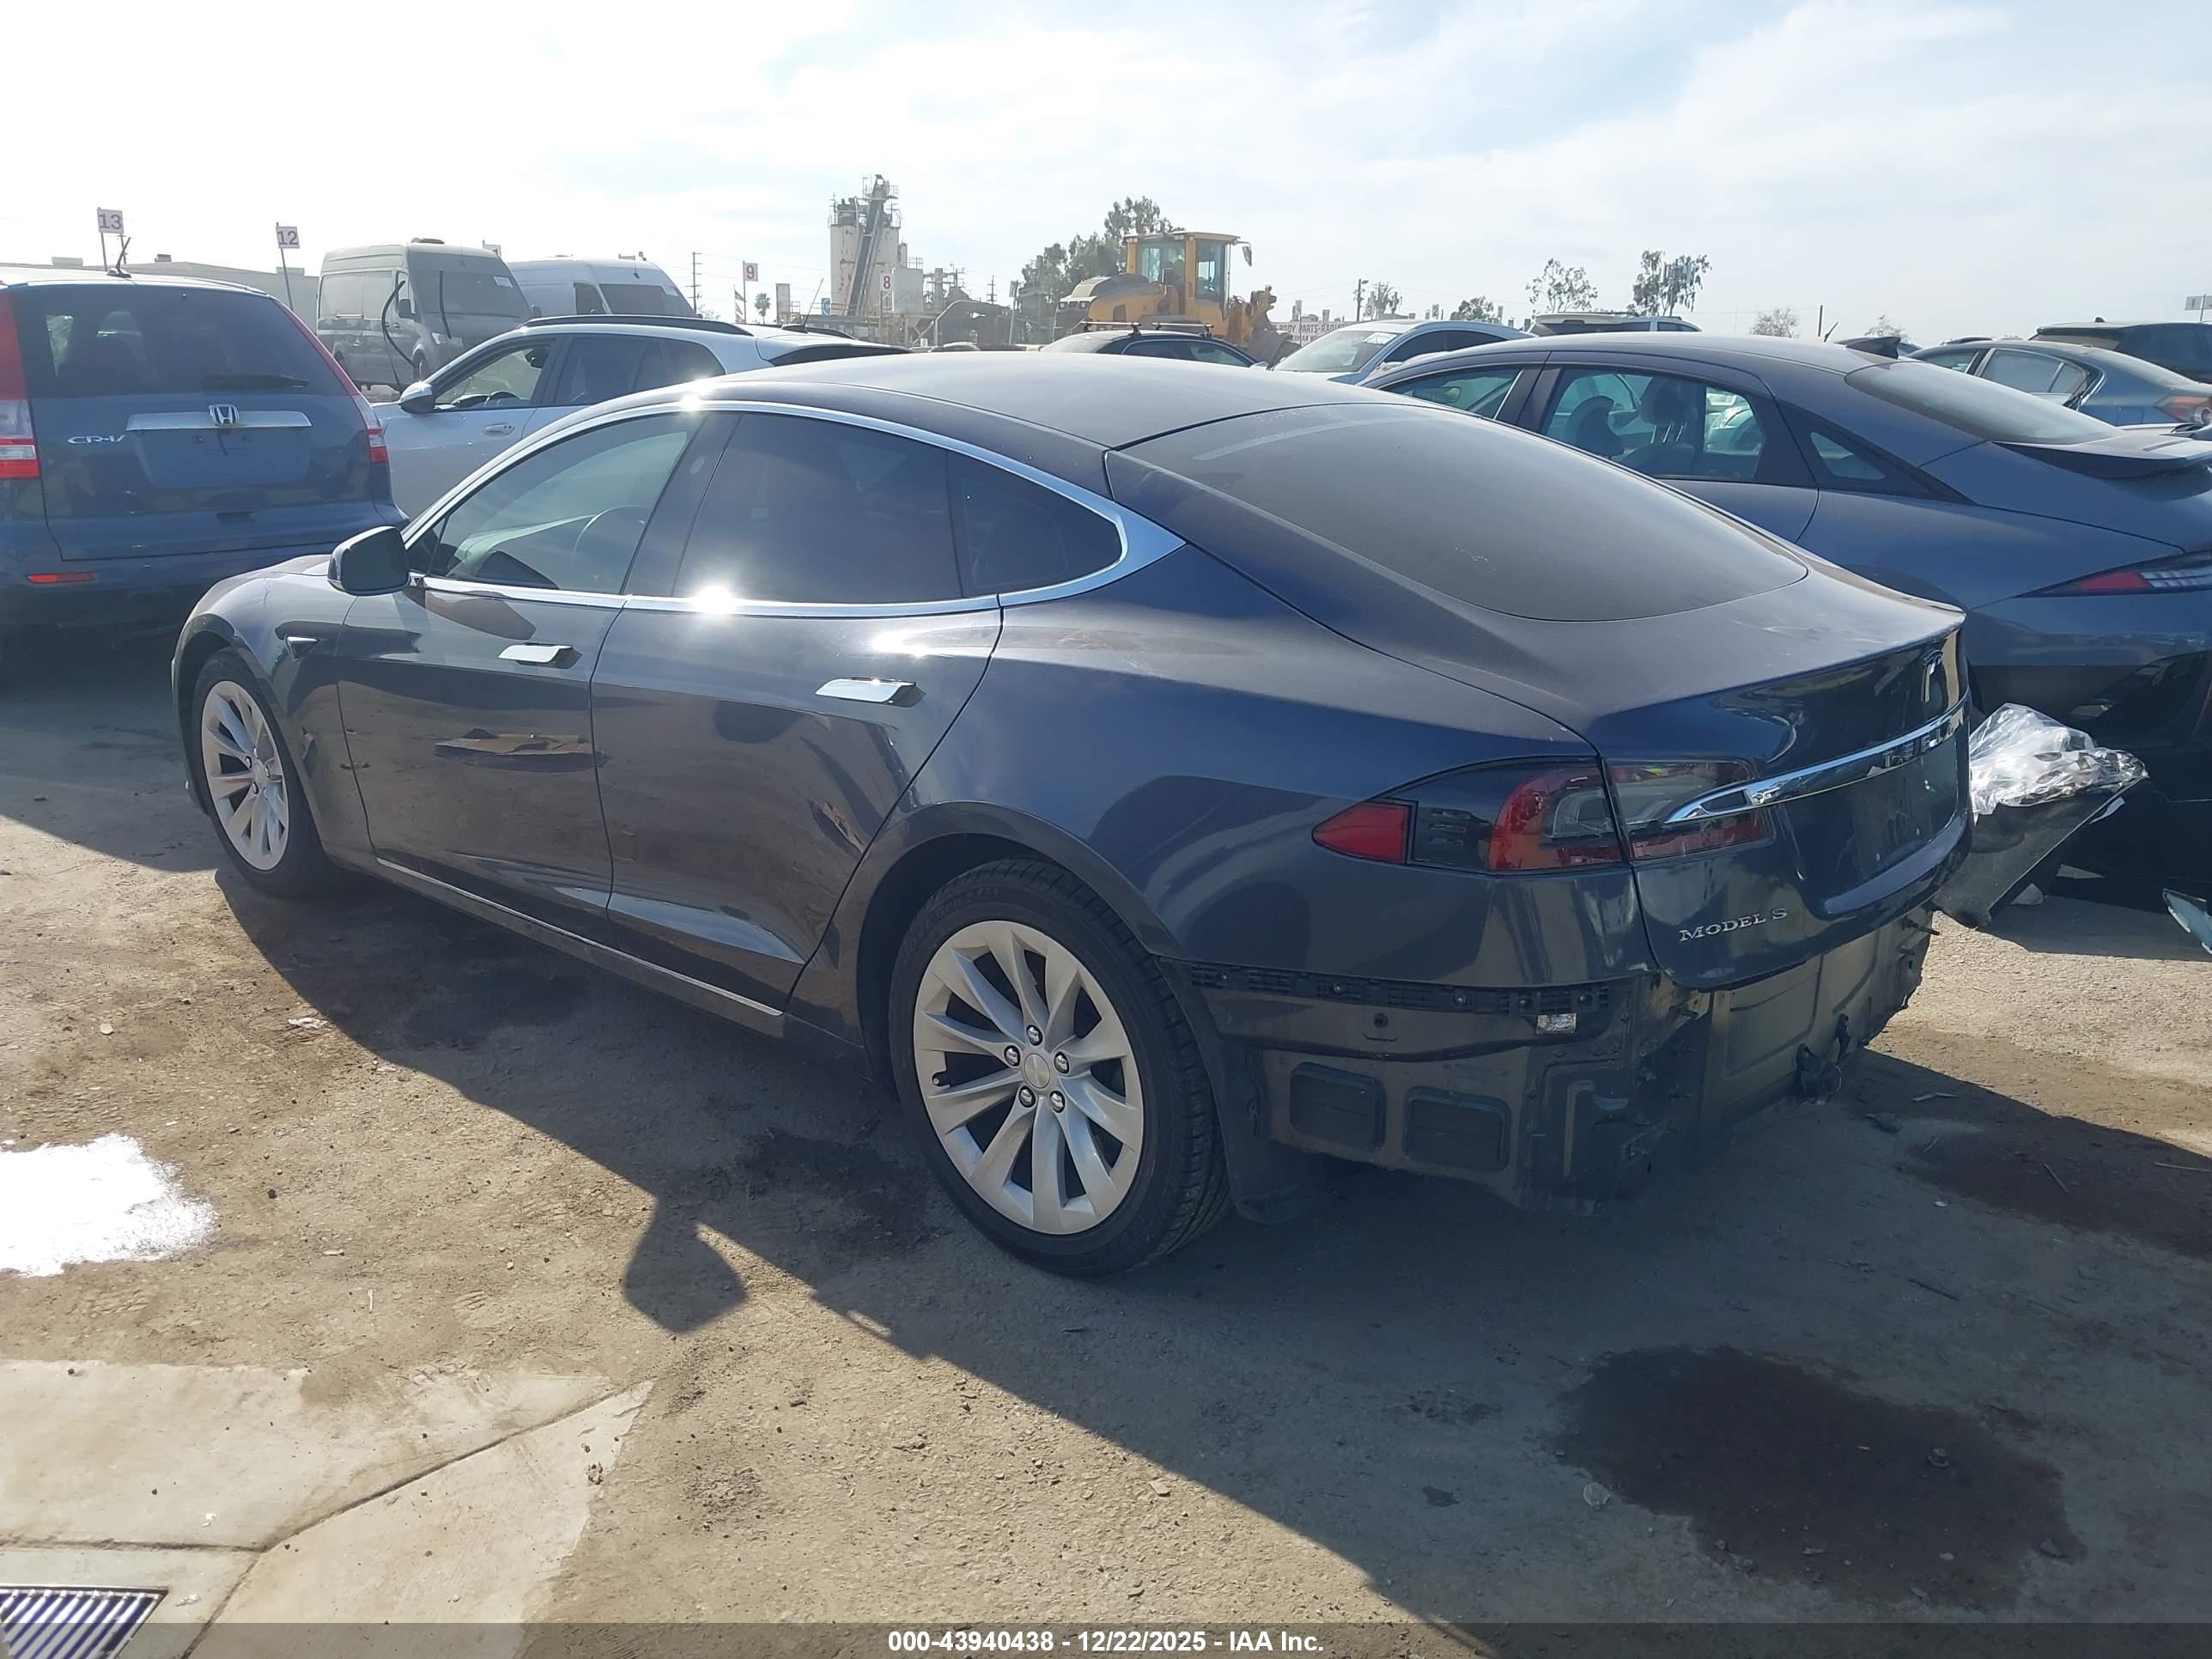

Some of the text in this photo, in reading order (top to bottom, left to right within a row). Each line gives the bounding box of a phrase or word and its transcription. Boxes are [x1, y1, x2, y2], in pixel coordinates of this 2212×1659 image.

[98, 213, 123, 230] 13
[276, 230, 299, 246] 12
[746, 264, 755, 279] 9
[884, 275, 891, 289] 8
[68, 434, 126, 445] CR-V
[1678, 907, 1788, 942] MODEL S
